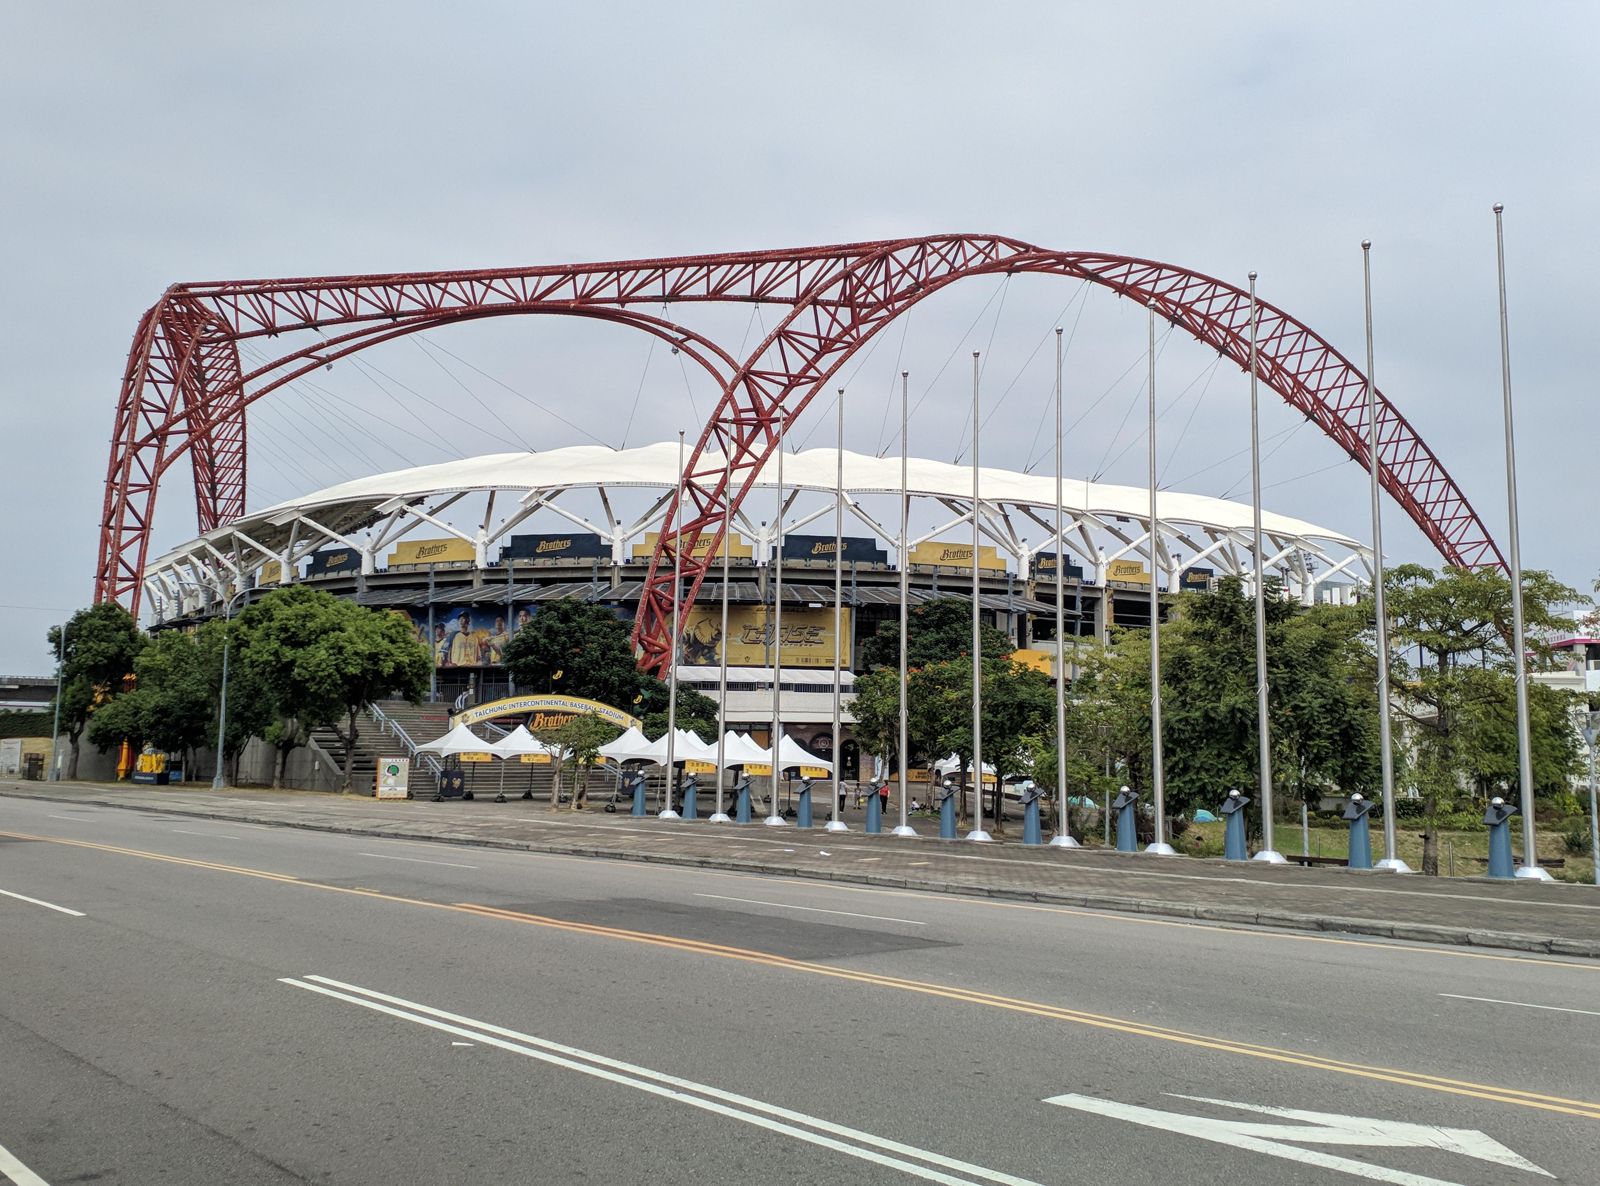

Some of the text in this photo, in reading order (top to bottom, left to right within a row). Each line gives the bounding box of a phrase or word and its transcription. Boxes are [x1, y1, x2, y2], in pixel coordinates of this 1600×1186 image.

[415, 543, 448, 559] Brothers
[535, 539, 572, 553] Brothers
[940, 549, 974, 561] Brothers
[1113, 565, 1141, 576] Brothers
[474, 703, 508, 718] TAICHUNG
[508, 699, 569, 710] INTERCONTINENTAL
[598, 707, 625, 721] STADIUM
